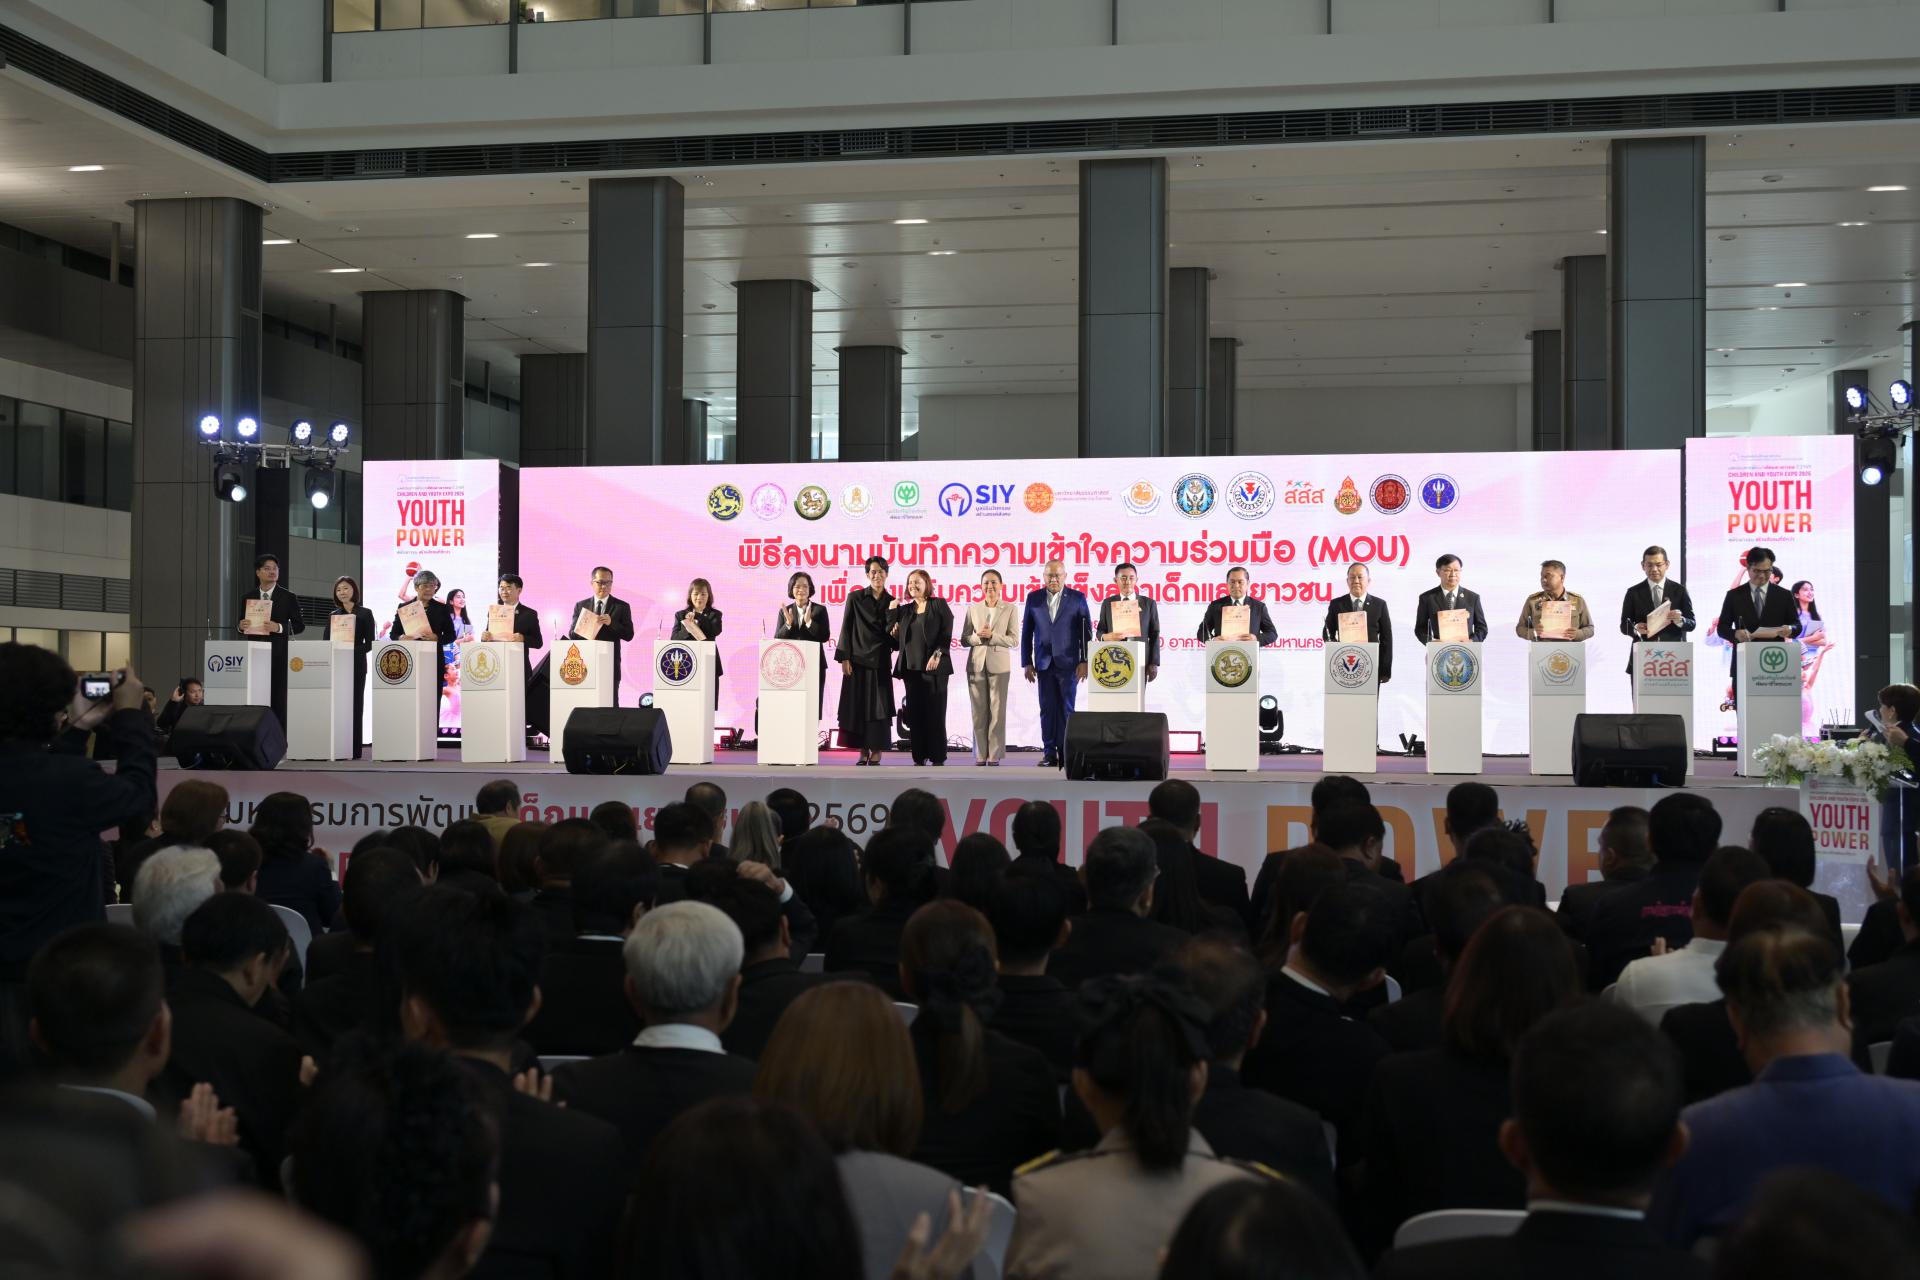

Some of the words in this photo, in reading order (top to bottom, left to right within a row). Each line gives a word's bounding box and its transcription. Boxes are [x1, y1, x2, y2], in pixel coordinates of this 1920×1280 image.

[976, 484, 1016, 504] SIY
[1285, 488, 1325, 504] สสส
[1728, 480, 1812, 511] YOUTH
[397, 499, 464, 527] YOUTH
[1728, 513, 1812, 534] POWER
[397, 528, 464, 547] POWER
[738, 529, 1296, 567] พิธีลงนามบันทึกความเข้าใจความร่วมมือ
[1308, 535, 1411, 567] (MOU)
[225, 656, 244, 667] SIY
[1643, 659, 1691, 677] สสส
[1809, 803, 1870, 830] YOUTH
